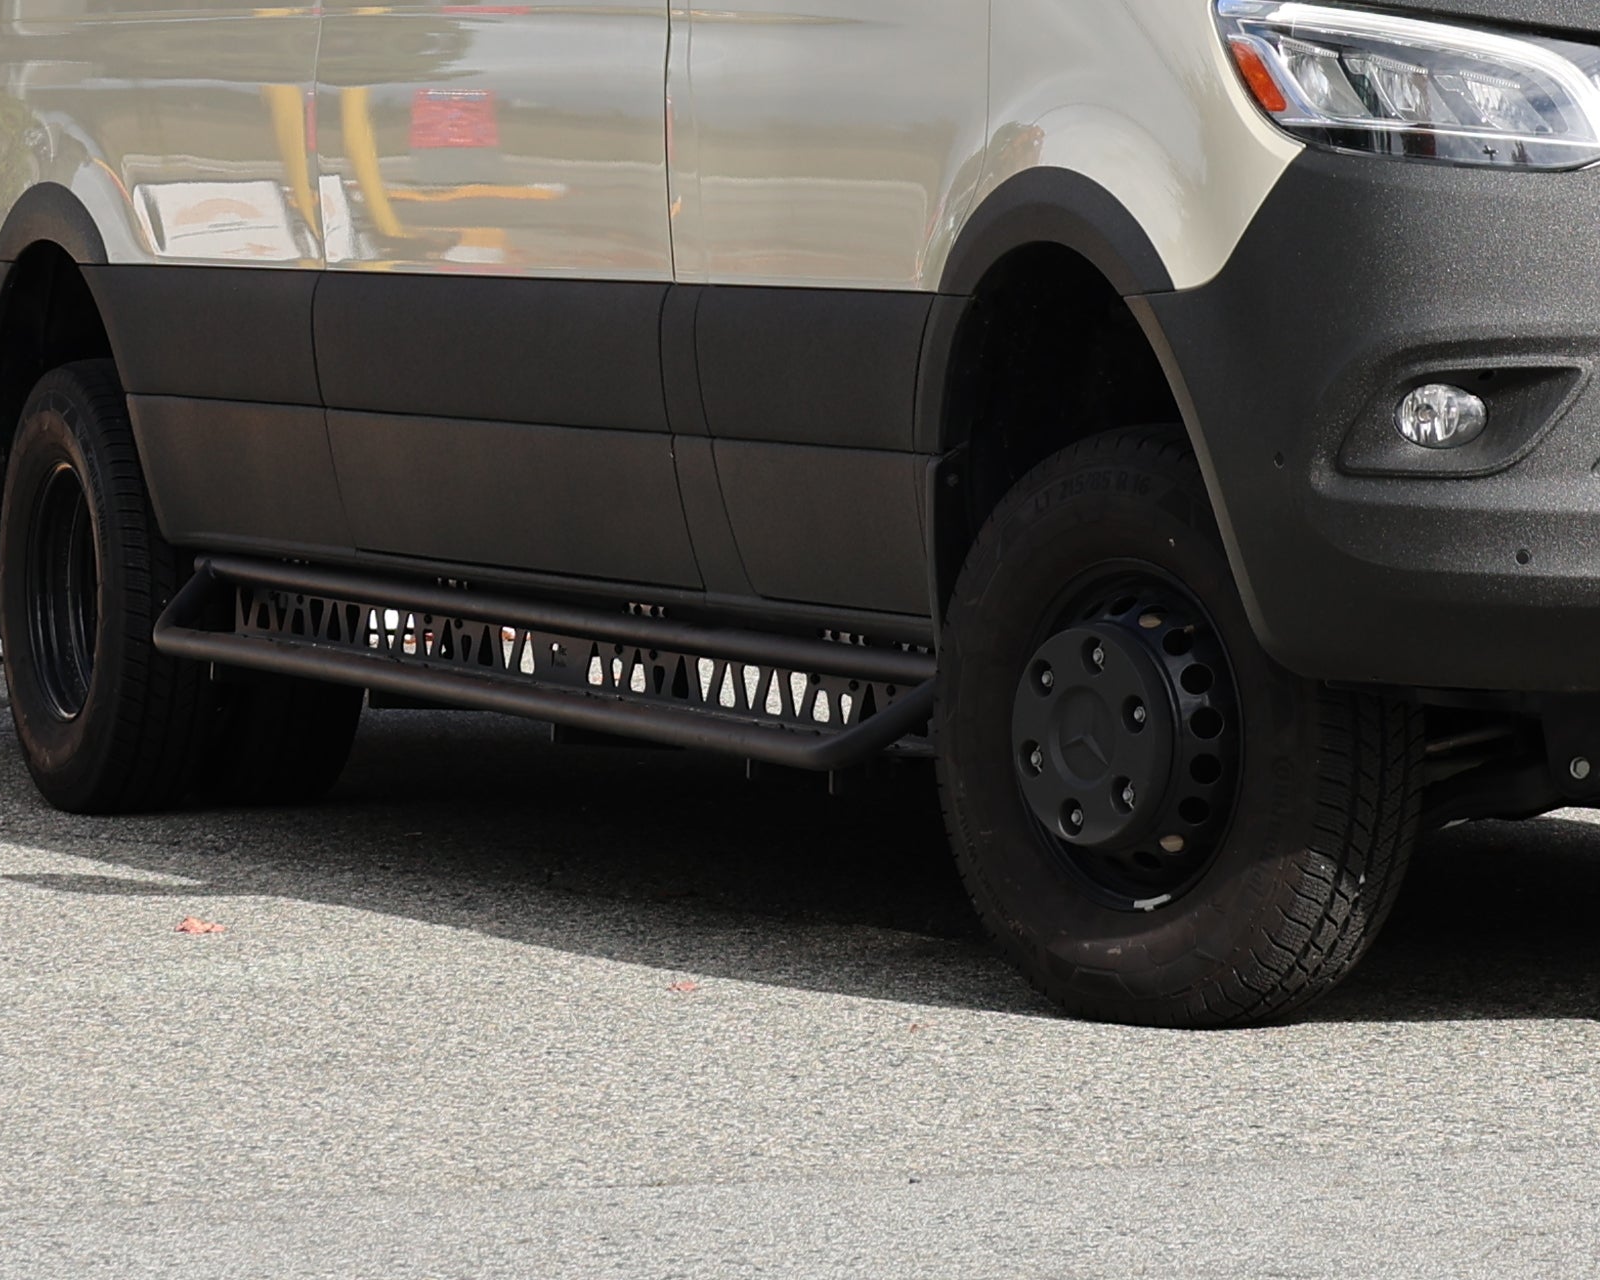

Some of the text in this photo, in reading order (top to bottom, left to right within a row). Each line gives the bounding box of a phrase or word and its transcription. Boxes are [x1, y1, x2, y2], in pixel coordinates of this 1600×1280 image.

[1058, 470, 1112, 501] 215/85
[1115, 471, 1129, 491] R
[1132, 473, 1152, 496] 16
